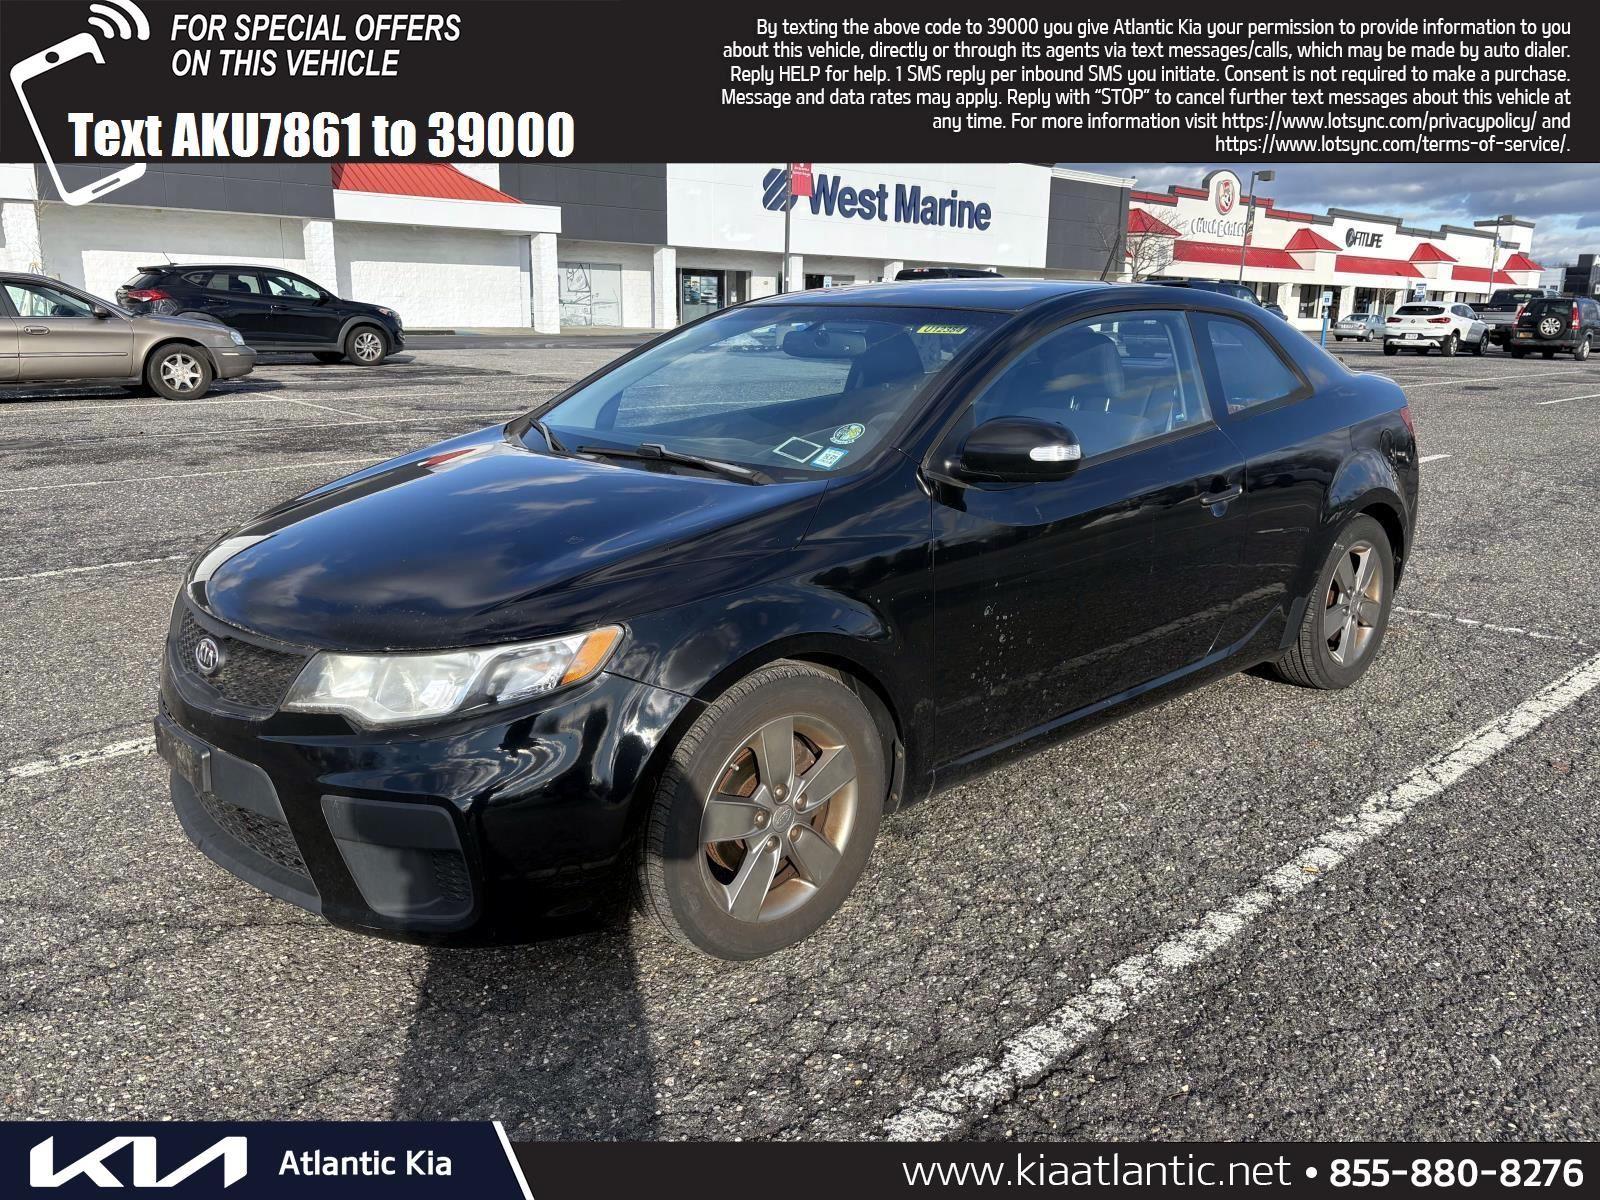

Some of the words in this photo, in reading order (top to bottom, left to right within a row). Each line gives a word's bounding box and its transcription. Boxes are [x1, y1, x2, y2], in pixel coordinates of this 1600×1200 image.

[809, 173, 888, 222] West
[895, 184, 992, 231] Marine
[1354, 231, 1384, 248] FITLIFE
